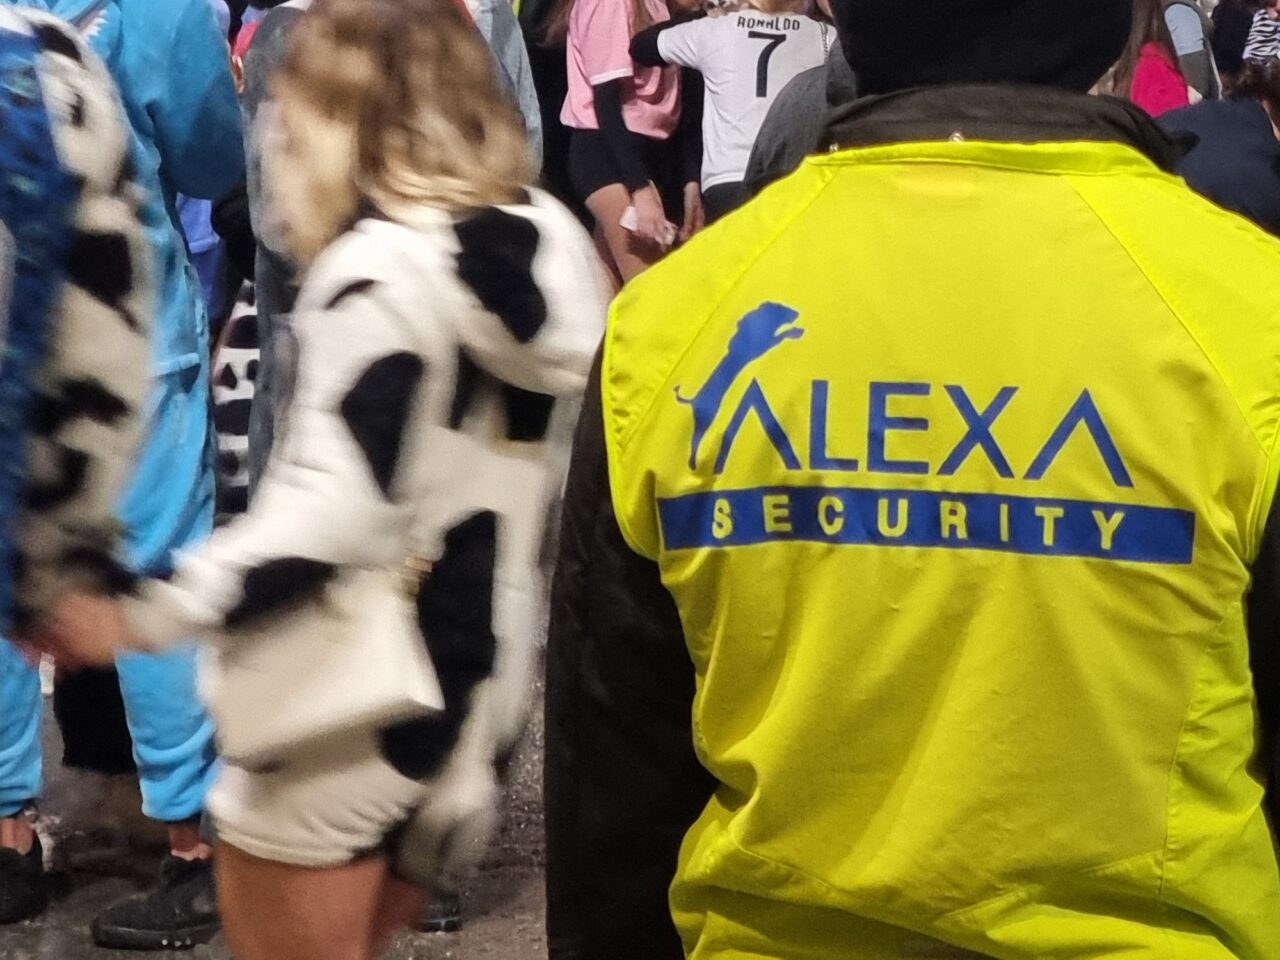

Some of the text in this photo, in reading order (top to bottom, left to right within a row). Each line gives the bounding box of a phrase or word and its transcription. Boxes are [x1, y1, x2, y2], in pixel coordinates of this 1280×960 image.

[737, 16, 800, 31] RONALDO
[748, 30, 787, 98] 7
[714, 378, 1133, 487] ALEXA
[712, 496, 1123, 549] SECURITY
